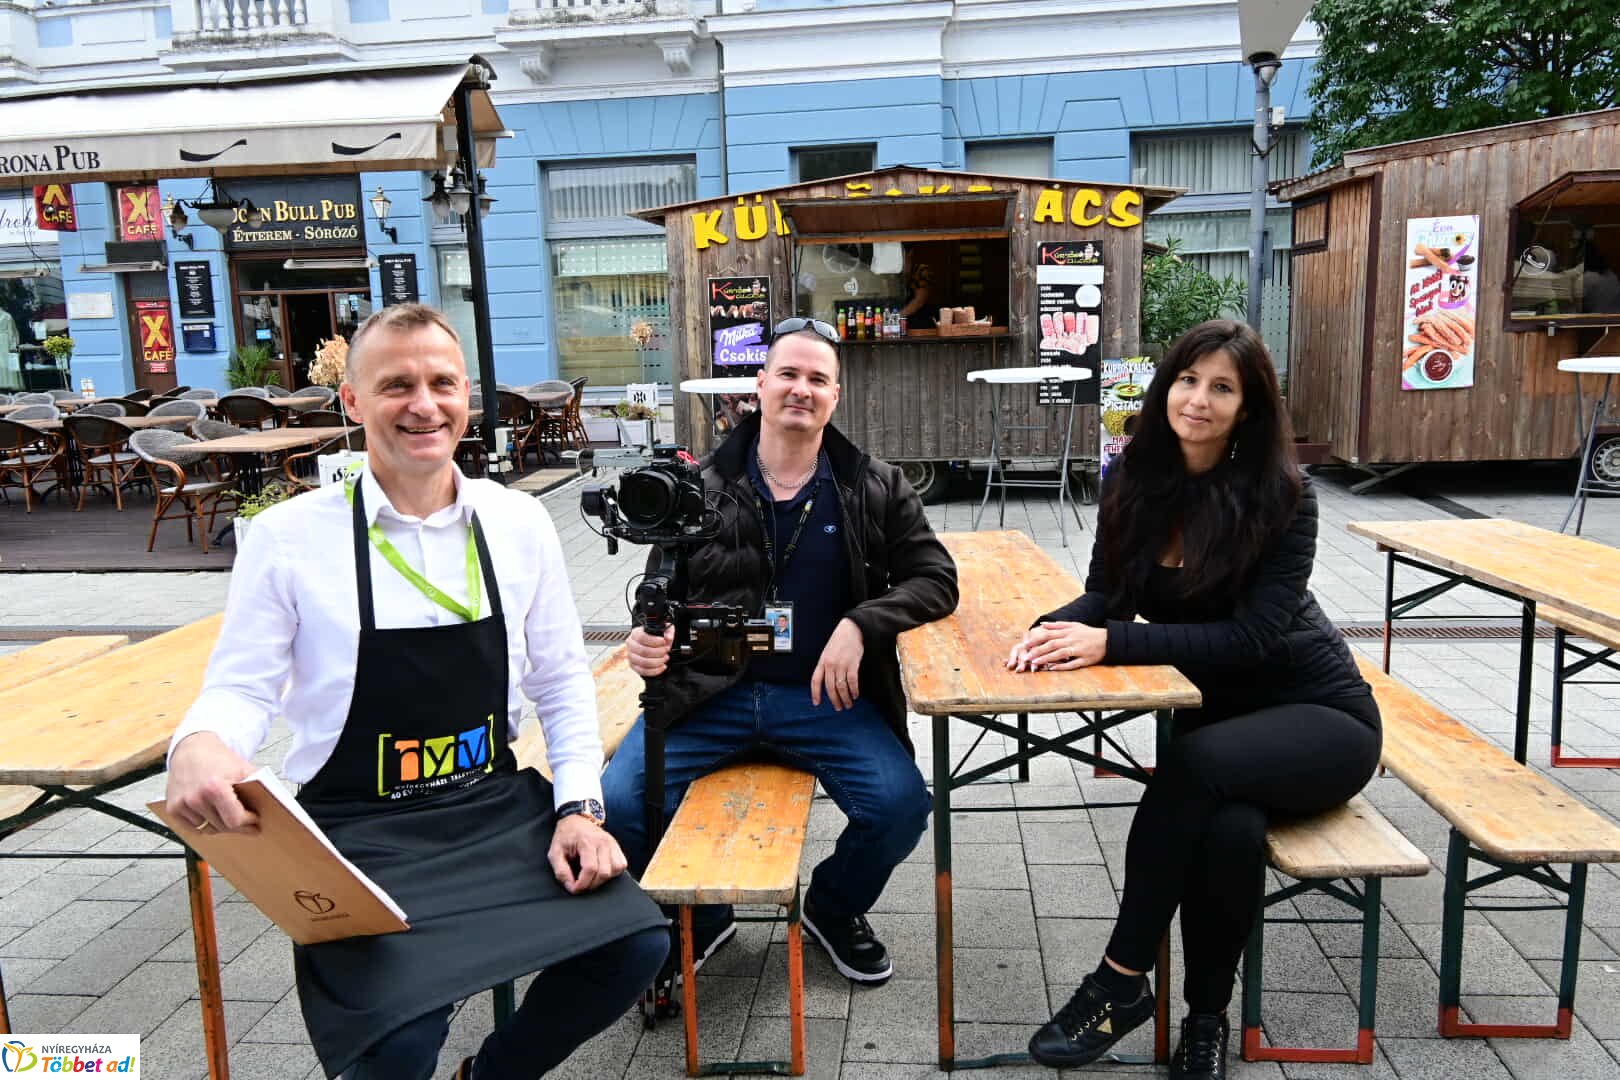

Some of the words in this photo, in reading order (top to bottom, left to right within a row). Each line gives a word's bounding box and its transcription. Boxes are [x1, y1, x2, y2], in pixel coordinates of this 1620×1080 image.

[54, 145, 101, 170] PUB
[126, 191, 155, 223] X
[274, 200, 319, 222] BULL
[320, 199, 356, 221] PUB
[231, 226, 293, 242] ÉTTEREM
[141, 314, 170, 348] X
[719, 347, 767, 362] Csokis
